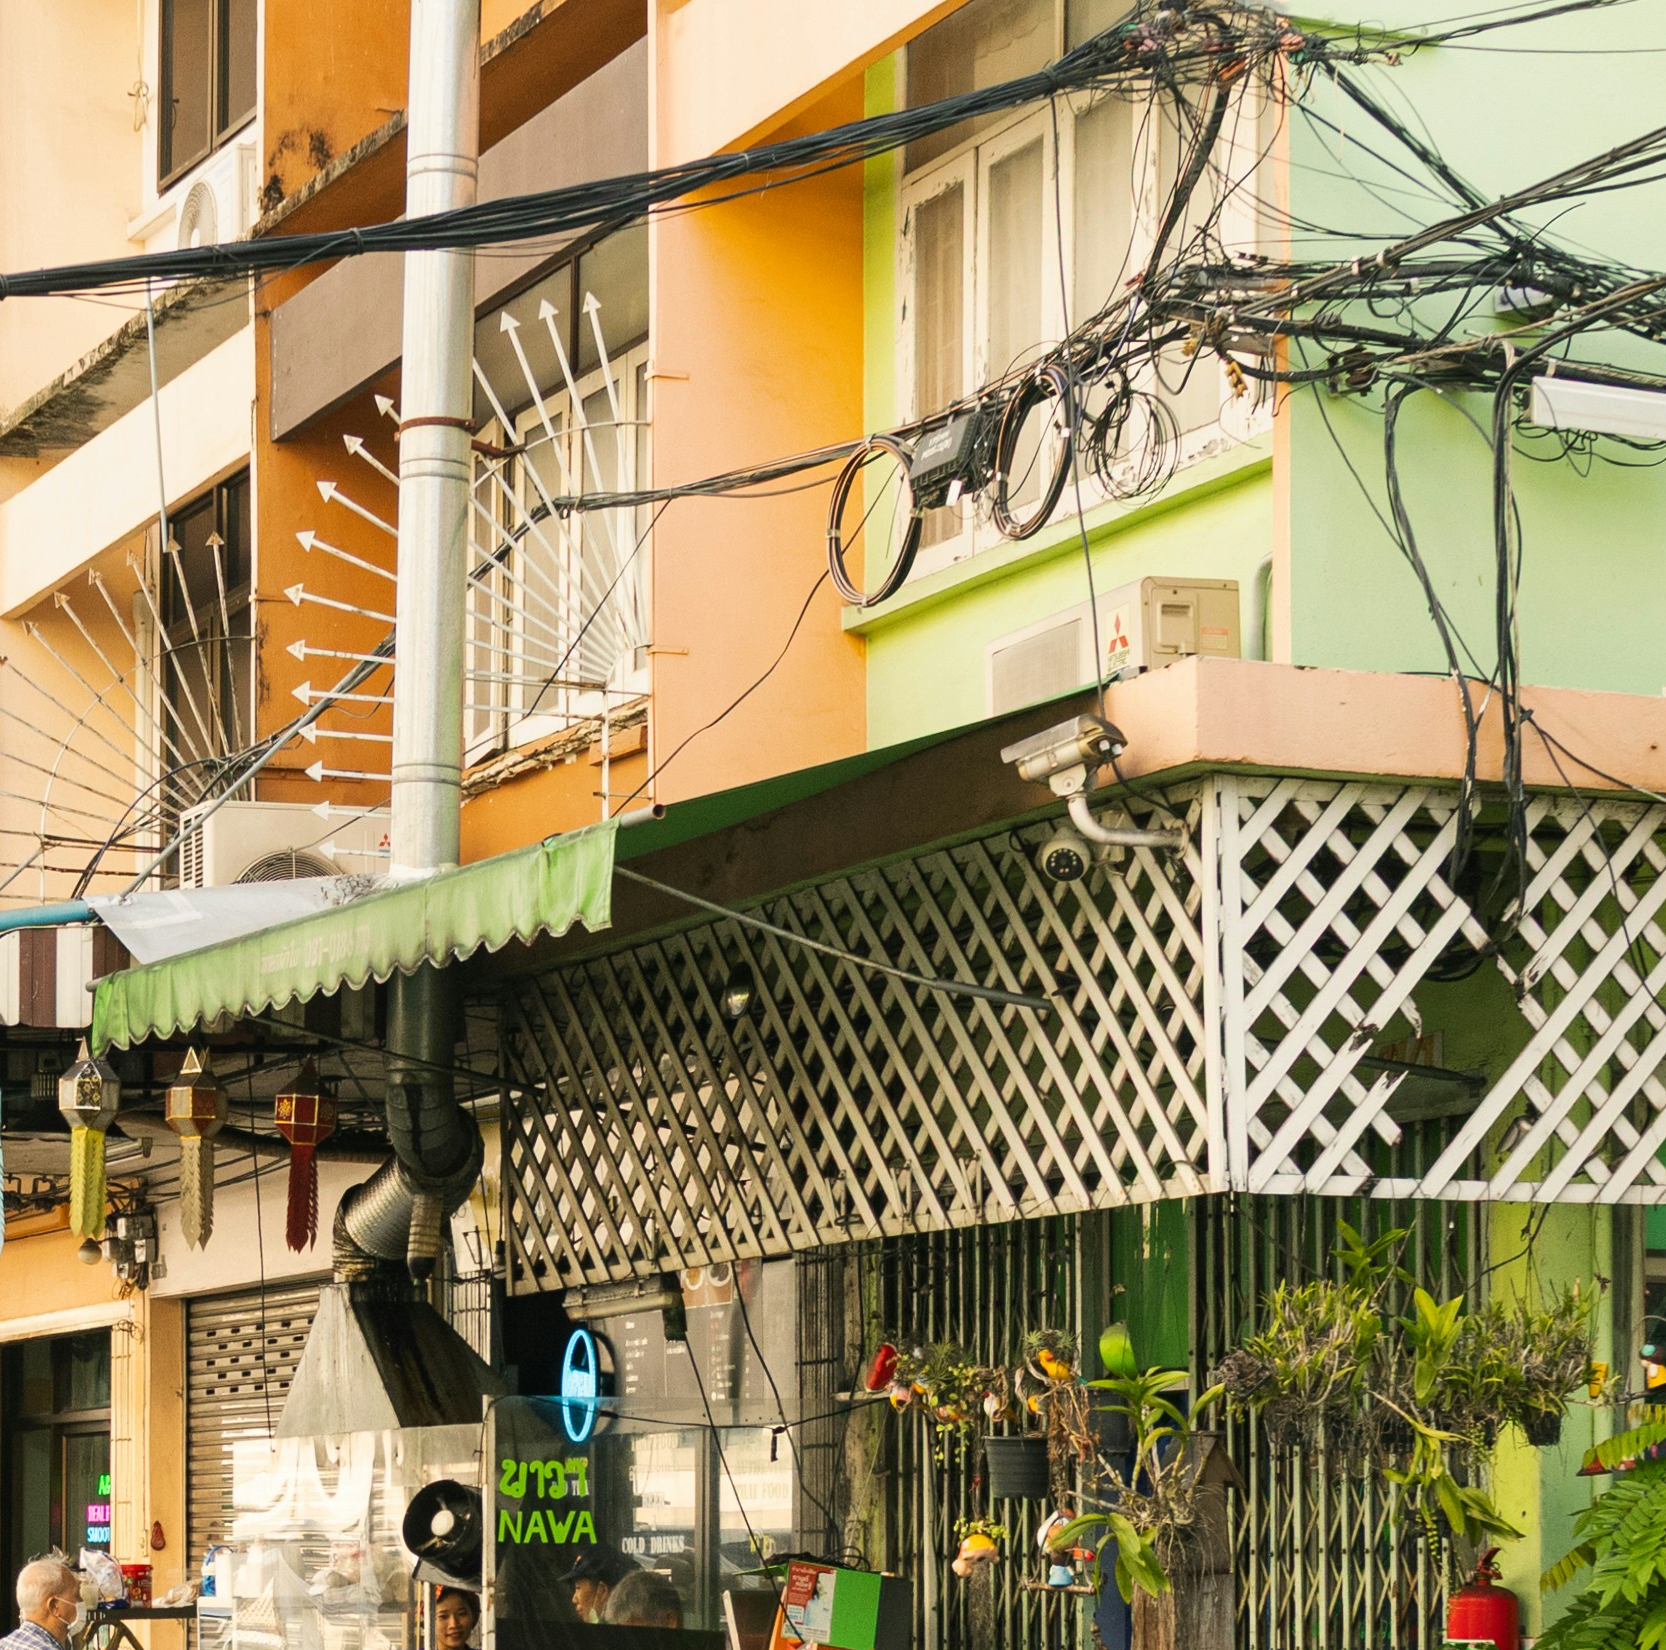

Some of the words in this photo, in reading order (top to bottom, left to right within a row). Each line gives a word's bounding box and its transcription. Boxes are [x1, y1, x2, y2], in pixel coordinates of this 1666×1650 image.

[499, 1458, 587, 1499] นาวา
[762, 1482, 789, 1499] FOOD
[498, 1509, 597, 1544] NAWA
[622, 1537, 645, 1554] COLD
[650, 1535, 685, 1554] DRINKS
